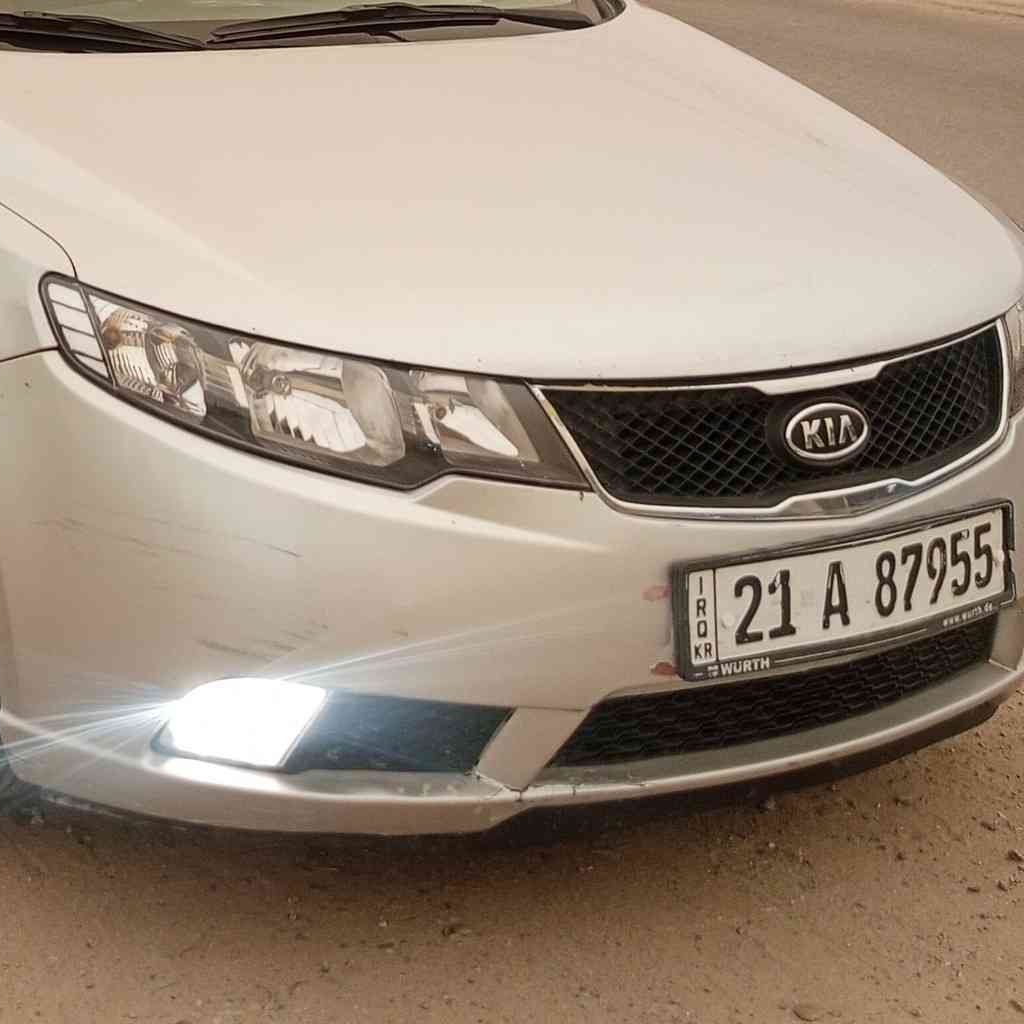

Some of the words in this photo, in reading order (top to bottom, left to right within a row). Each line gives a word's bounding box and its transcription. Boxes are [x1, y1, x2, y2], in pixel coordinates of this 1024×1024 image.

[800, 414, 859, 450] KIA
[734, 569, 797, 646] 21
[822, 561, 851, 630] A
[875, 522, 993, 618] 87955
[694, 641, 714, 660] KR
